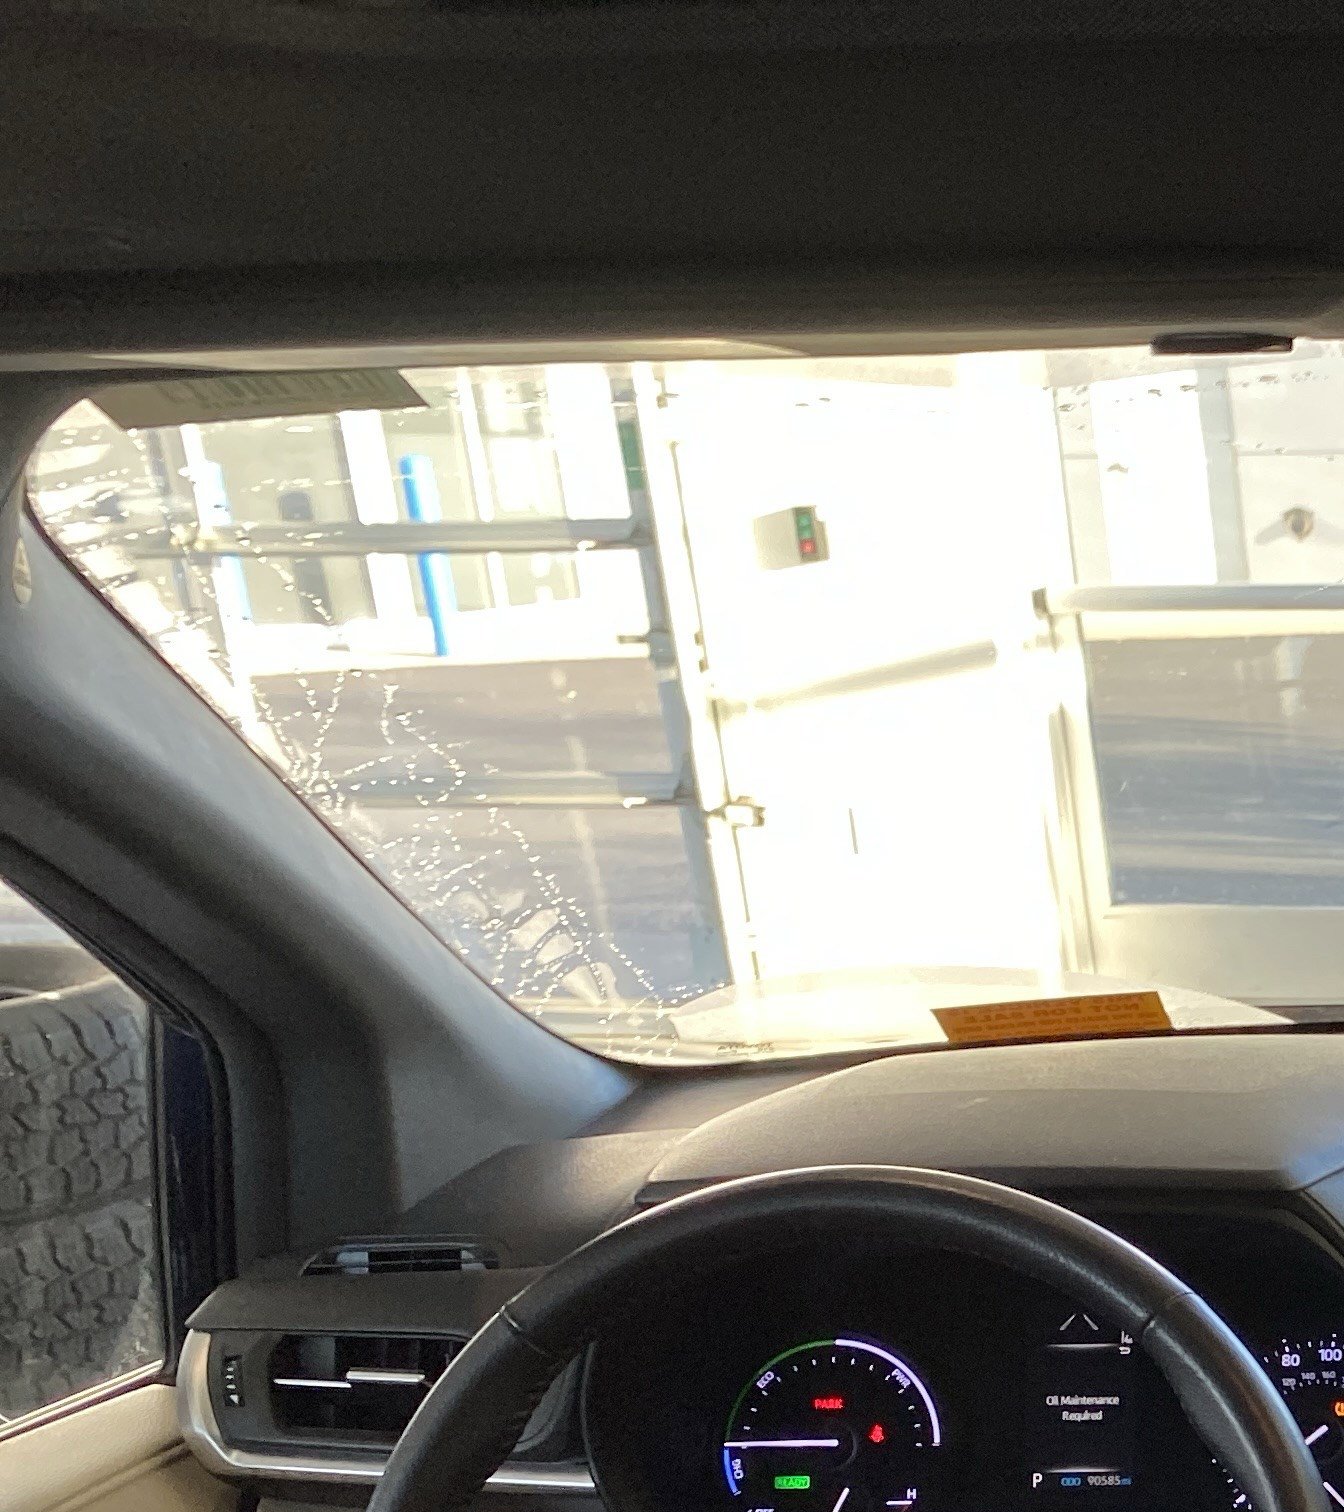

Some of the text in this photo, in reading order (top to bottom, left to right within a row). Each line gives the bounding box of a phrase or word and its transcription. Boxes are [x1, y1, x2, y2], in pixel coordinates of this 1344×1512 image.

[1281, 1353, 1301, 1367] 80
[1318, 1348, 1343, 1362] 100
[1046, 1394, 1120, 1406] Oil Maintenance
[1062, 1410, 1103, 1422] Required
[1032, 1472, 1043, 1488] P
[906, 1488, 917, 1500] H
